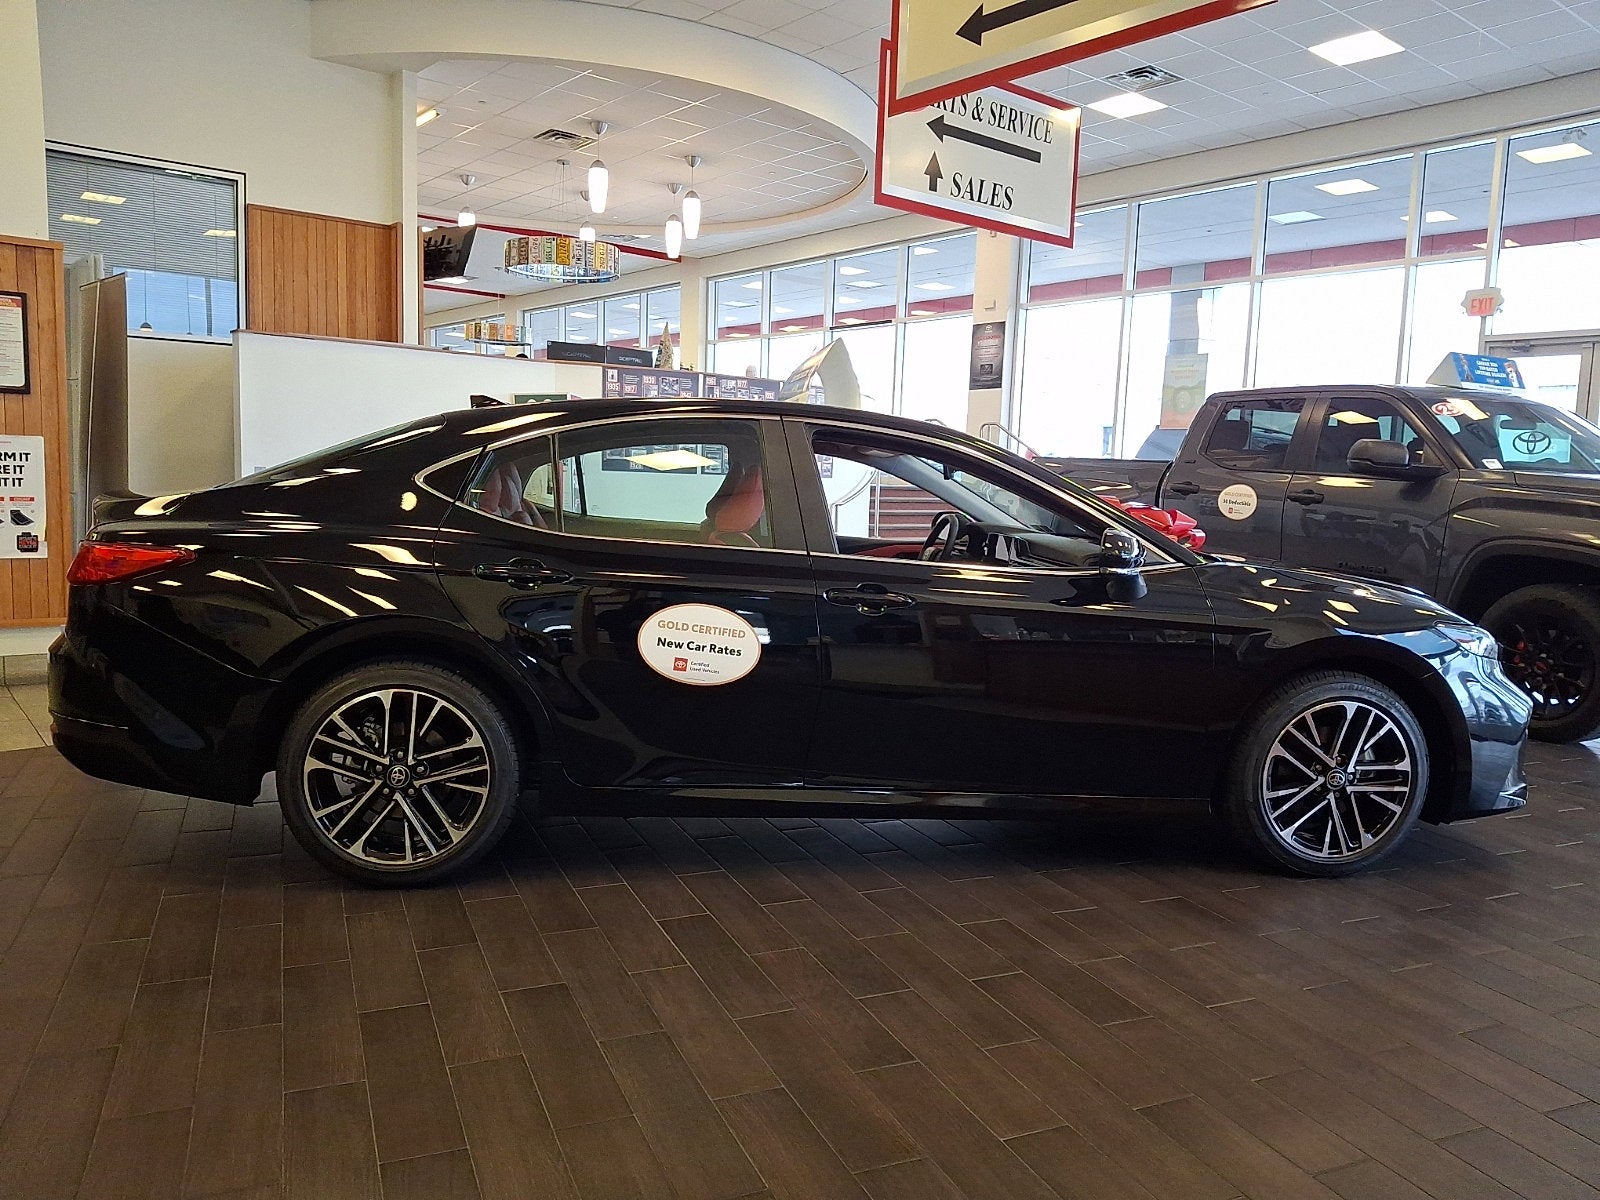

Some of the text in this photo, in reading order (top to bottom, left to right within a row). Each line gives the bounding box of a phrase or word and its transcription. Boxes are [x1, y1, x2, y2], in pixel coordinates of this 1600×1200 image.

[971, 96, 985, 122] &
[988, 101, 1054, 144] SERVICE
[950, 171, 1014, 211] SALES
[1471, 296, 1495, 312] EXIT
[19, 452, 31, 462] IT
[13, 465, 25, 474] IT
[0, 477, 24, 487] T IT
[657, 619, 746, 639] GOLD CERTIFIED
[656, 636, 742, 657] New Car Rates
